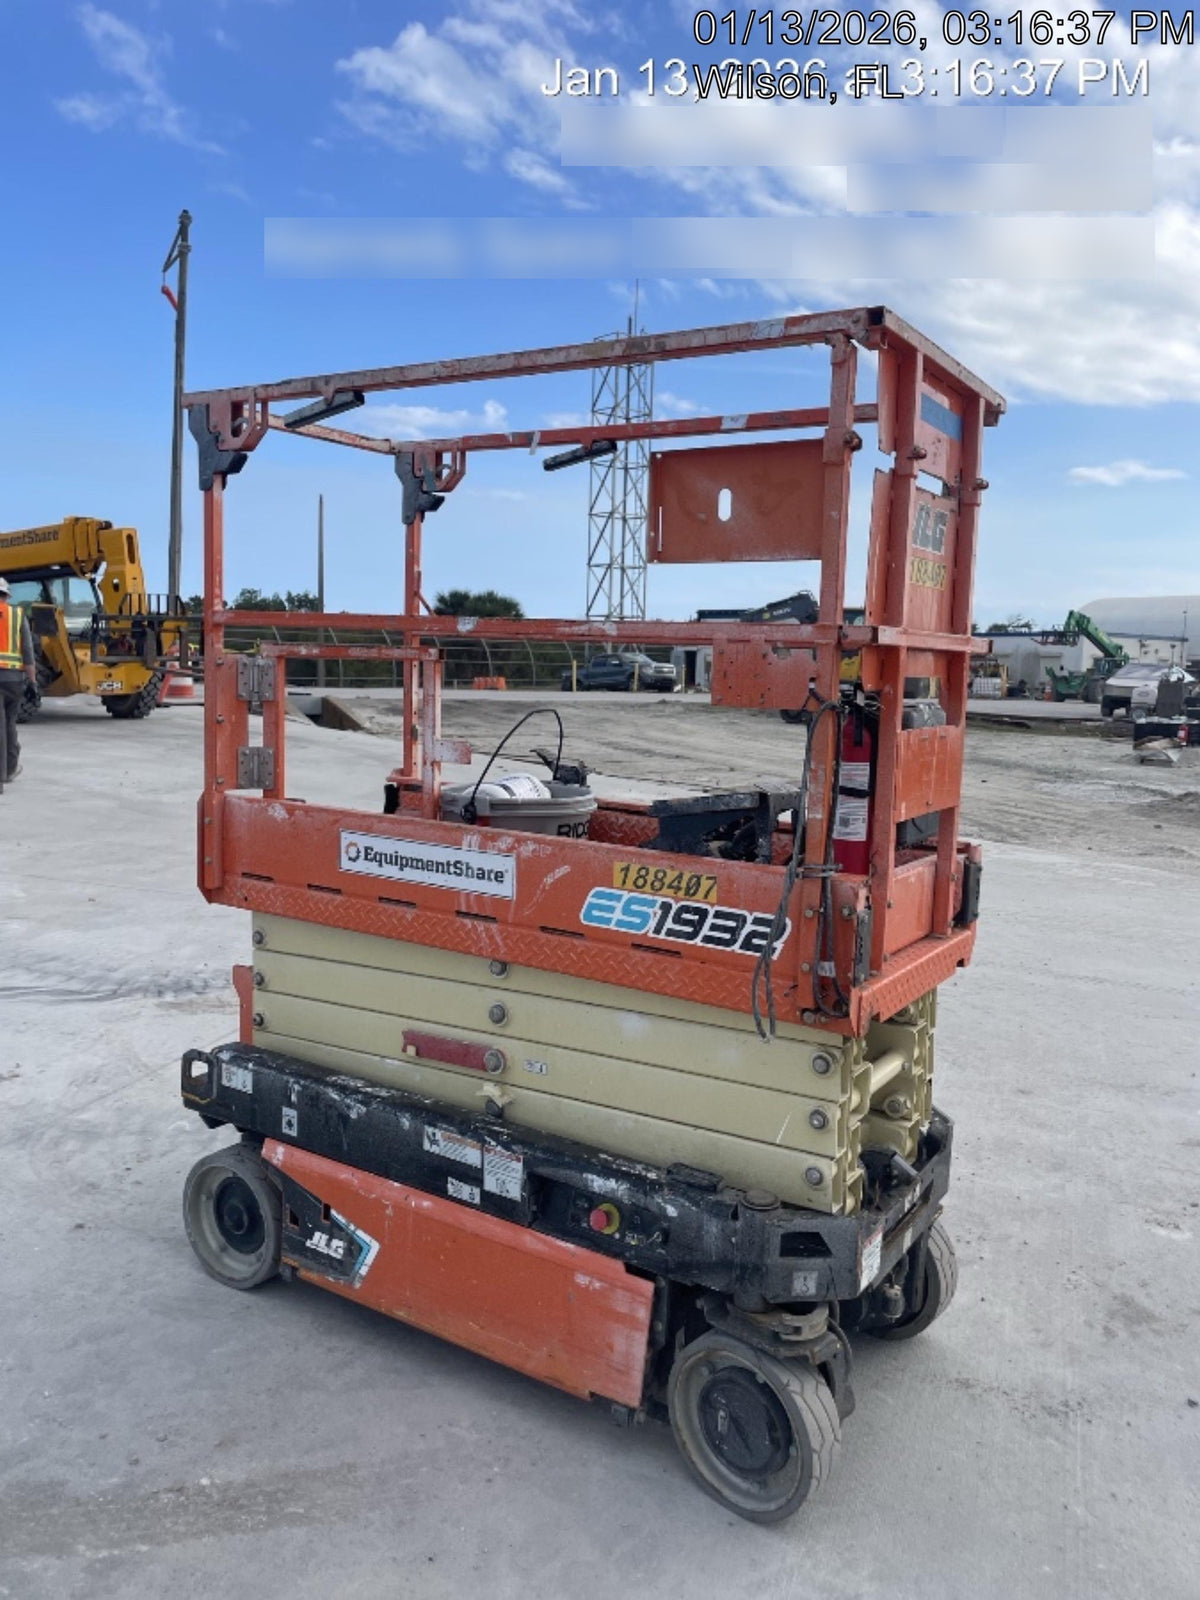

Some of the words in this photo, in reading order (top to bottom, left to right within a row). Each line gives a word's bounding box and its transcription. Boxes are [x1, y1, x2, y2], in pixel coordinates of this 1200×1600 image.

[362, 845, 507, 883] EquipmentShare
[618, 863, 718, 900] 188407
[581, 888, 790, 958] ES1932
[305, 1231, 346, 1260] JLG
